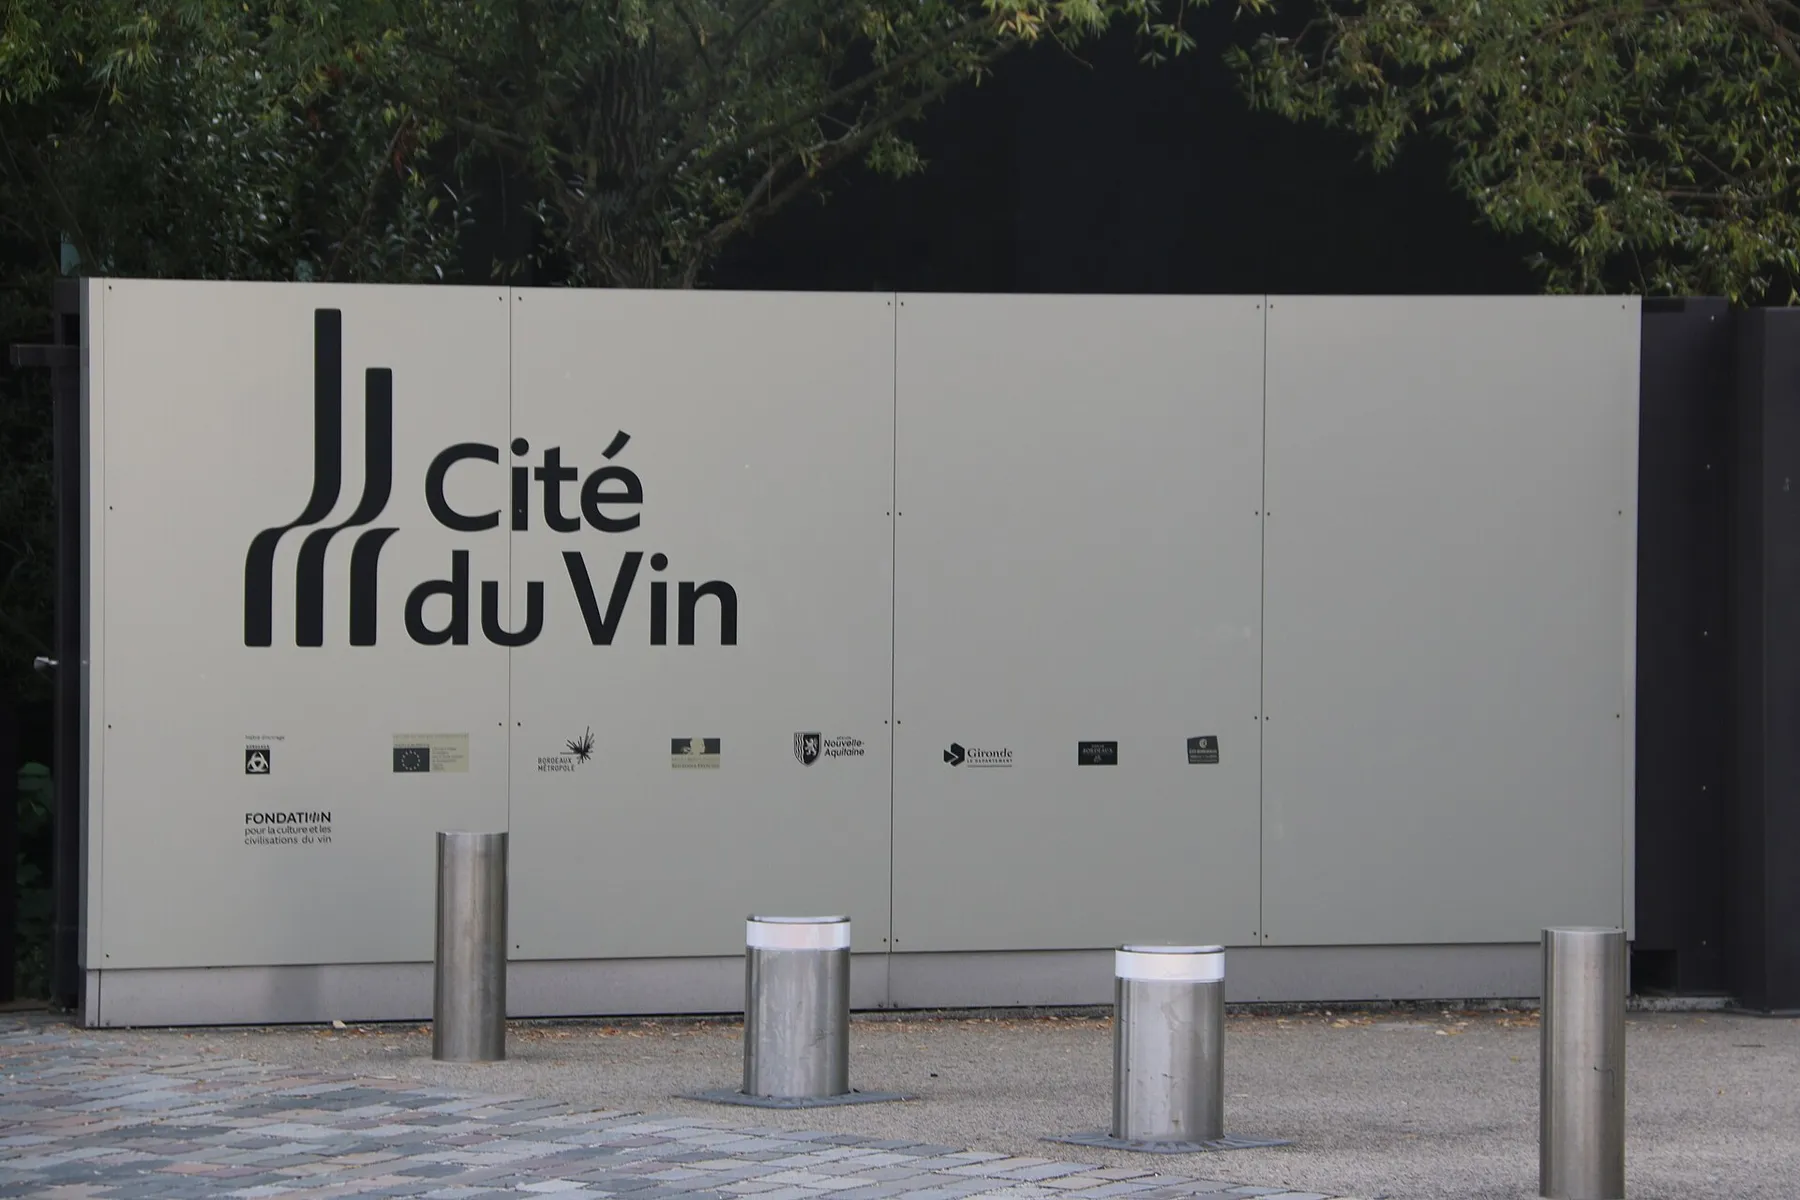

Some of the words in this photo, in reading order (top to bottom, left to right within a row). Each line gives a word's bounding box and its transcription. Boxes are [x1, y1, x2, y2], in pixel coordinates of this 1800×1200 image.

[425, 430, 643, 533] Cité
[404, 550, 544, 647] du
[562, 551, 738, 646] Vin
[824, 748, 865, 758] Aquitaine
[967, 747, 1013, 758] Gironde
[244, 827, 266, 836] pour
[268, 825, 275, 834] la
[276, 825, 307, 834] culture
[309, 825, 318, 834] et
[319, 825, 331, 833] les
[244, 836, 298, 845] civilisations
[301, 835, 314, 844] du
[317, 835, 331, 843] vin
